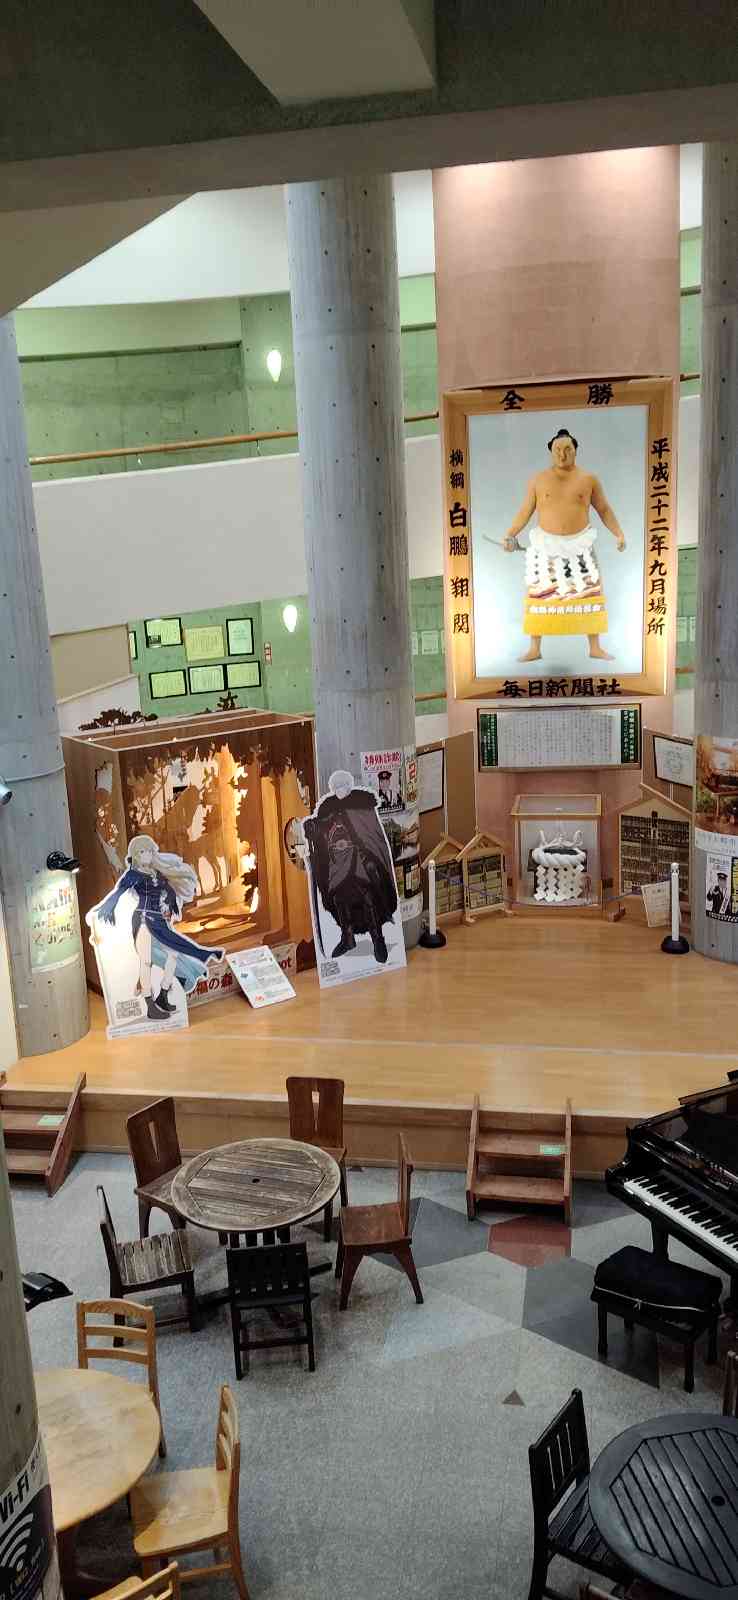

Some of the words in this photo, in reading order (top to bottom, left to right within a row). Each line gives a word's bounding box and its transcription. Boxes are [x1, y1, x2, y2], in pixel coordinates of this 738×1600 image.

[500, 389, 525, 411] 全
[587, 383, 614, 405] 勝
[648, 437, 671, 636] 平成二十二年九月場所
[496, 677, 622, 698] 毎日新聞社
